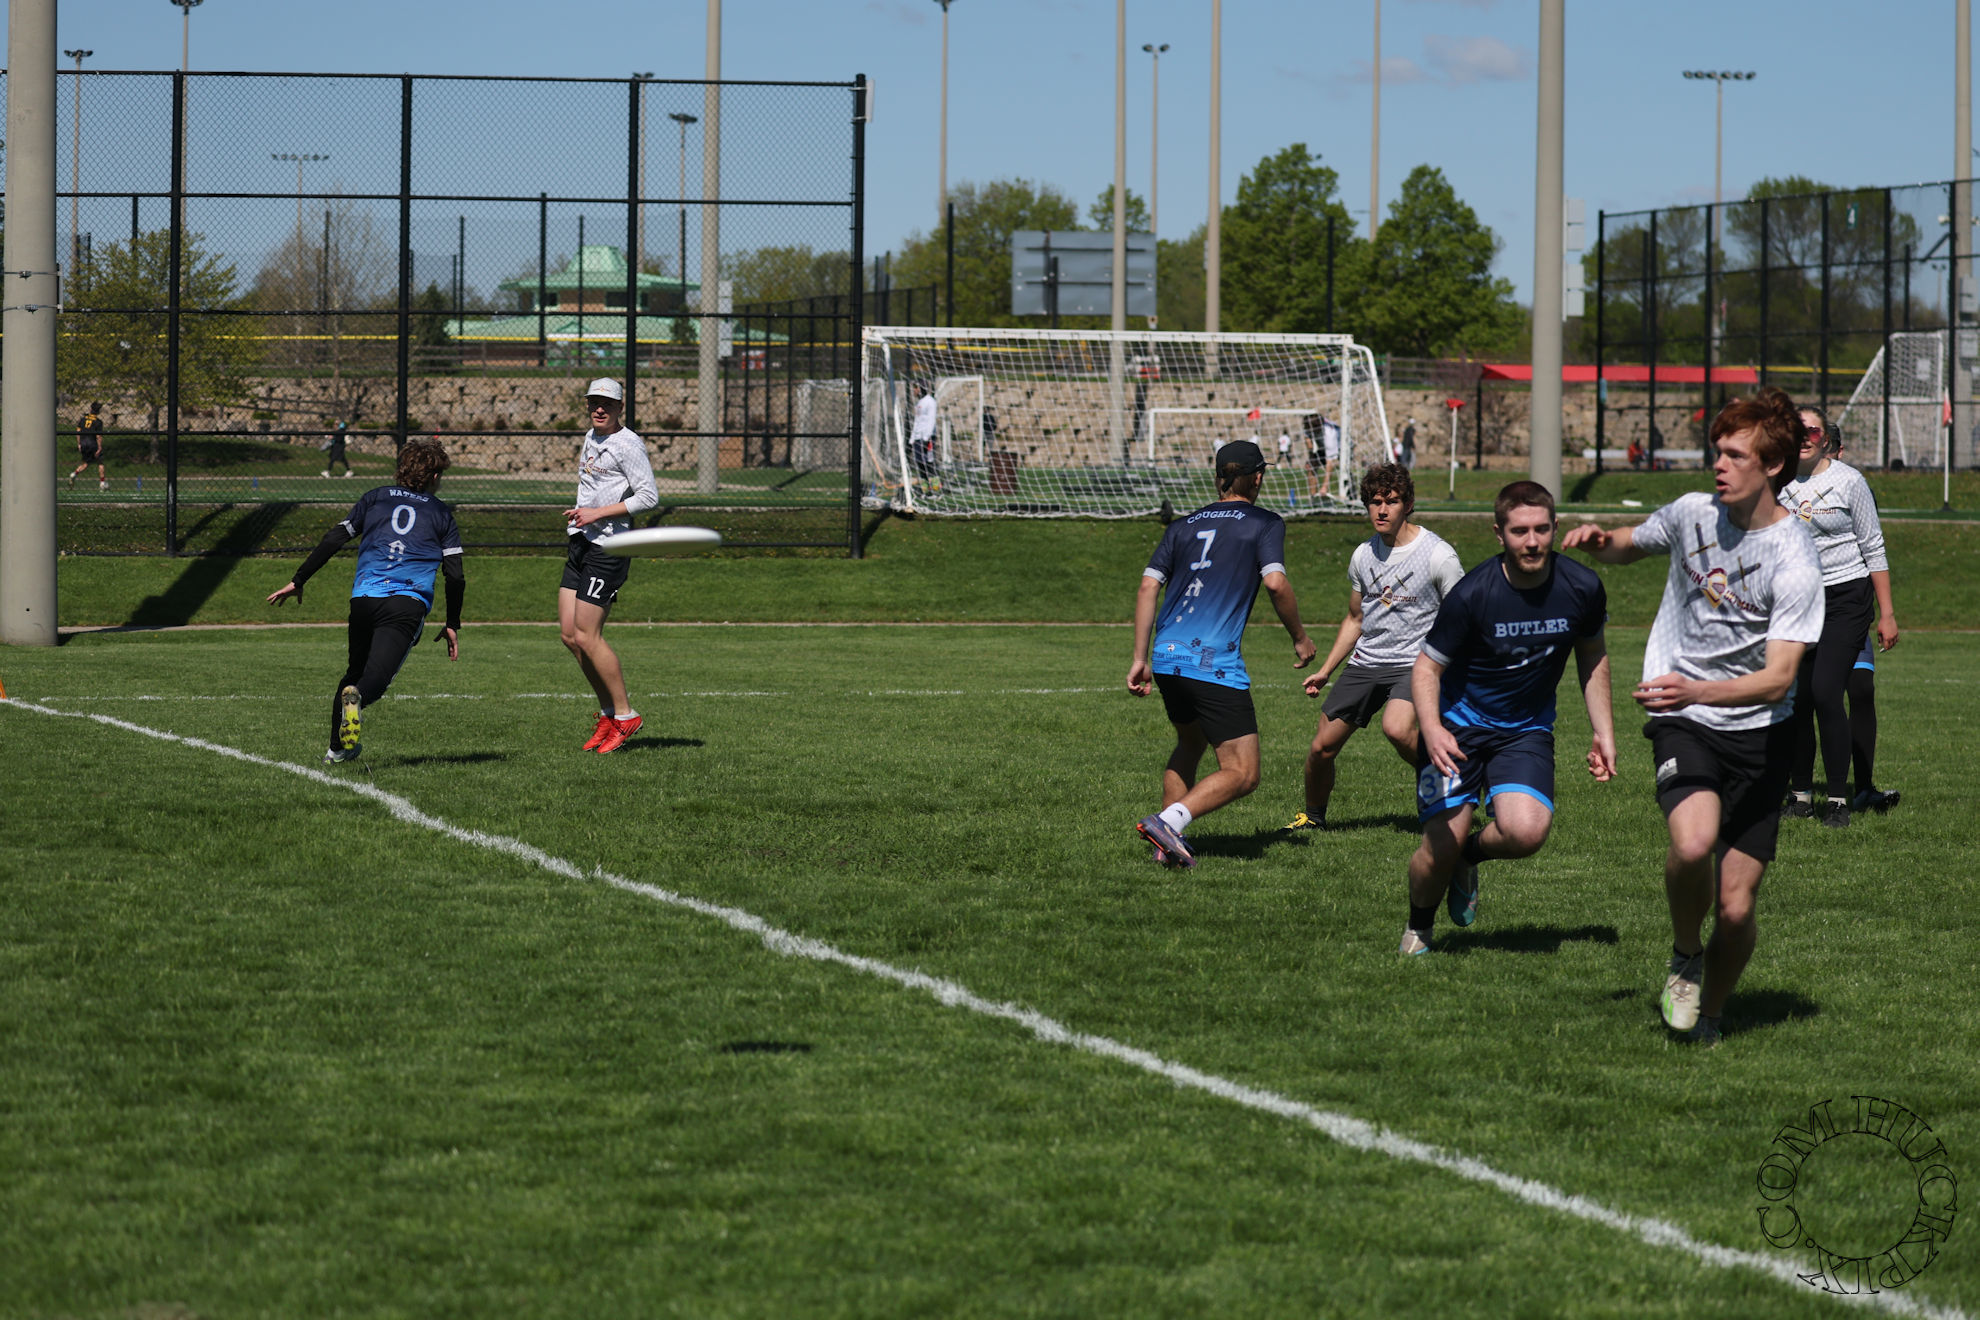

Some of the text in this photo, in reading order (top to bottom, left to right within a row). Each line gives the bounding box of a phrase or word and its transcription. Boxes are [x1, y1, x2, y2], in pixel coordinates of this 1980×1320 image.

[389, 489, 430, 503] WATERS
[391, 504, 417, 536] 0
[1187, 509, 1246, 524] COUGHLIN
[586, 576, 605, 599] 12
[1392, 594, 1418, 603] ULTIMATE
[1494, 617, 1570, 638] BUTLER
